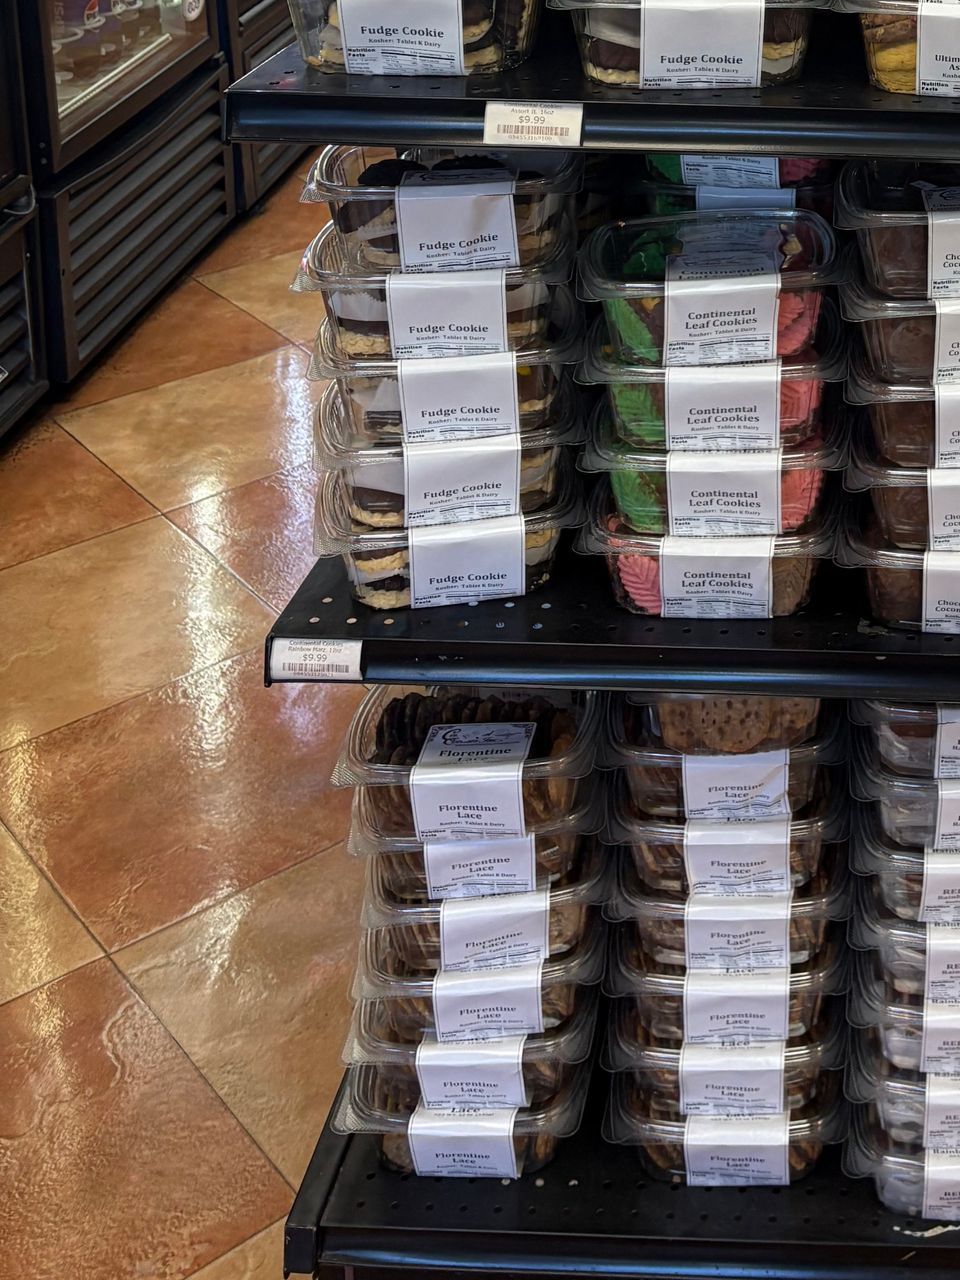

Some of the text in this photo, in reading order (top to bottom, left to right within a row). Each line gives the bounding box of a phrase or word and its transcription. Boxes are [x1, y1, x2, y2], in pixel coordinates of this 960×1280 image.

[361, 26, 444, 38] Fudge Cookie
[661, 54, 742, 65] Fudge Cookie
[518, 115, 546, 125] $9.99
[688, 308, 755, 320] Continental
[686, 316, 757, 329] Leaf Cookies
[409, 324, 488, 334] Fudge Cookie
[430, 573, 507, 584] Fudge Cookie
[708, 580, 753, 589] Cookies
[302, 654, 328, 662] $9.99
[440, 748, 512, 757] Florentine
